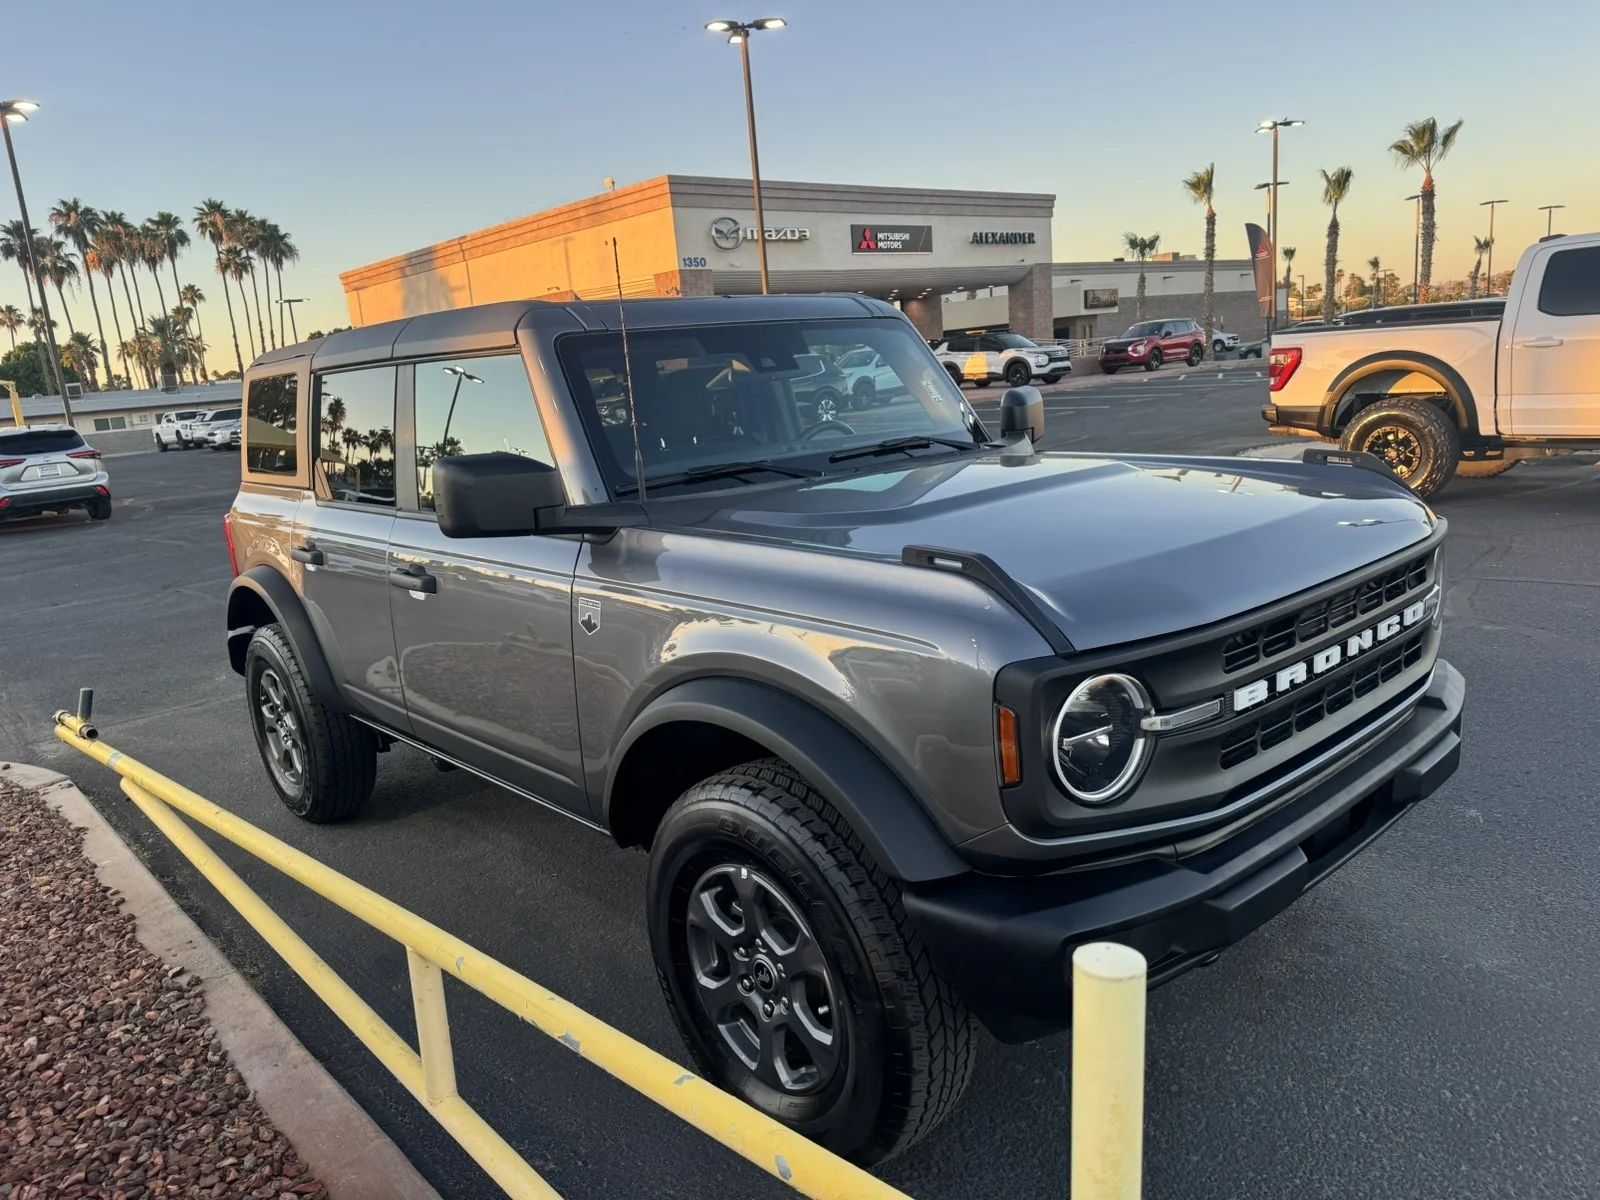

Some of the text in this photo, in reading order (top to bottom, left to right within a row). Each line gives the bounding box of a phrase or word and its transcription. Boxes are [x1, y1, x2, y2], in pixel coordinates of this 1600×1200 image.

[877, 232, 910, 241] MITSUBISHI
[969, 231, 1036, 245] ALEXANDER
[877, 241, 903, 249] MOTORS
[682, 256, 707, 268] 1350
[1233, 601, 1424, 712] BRONCO
